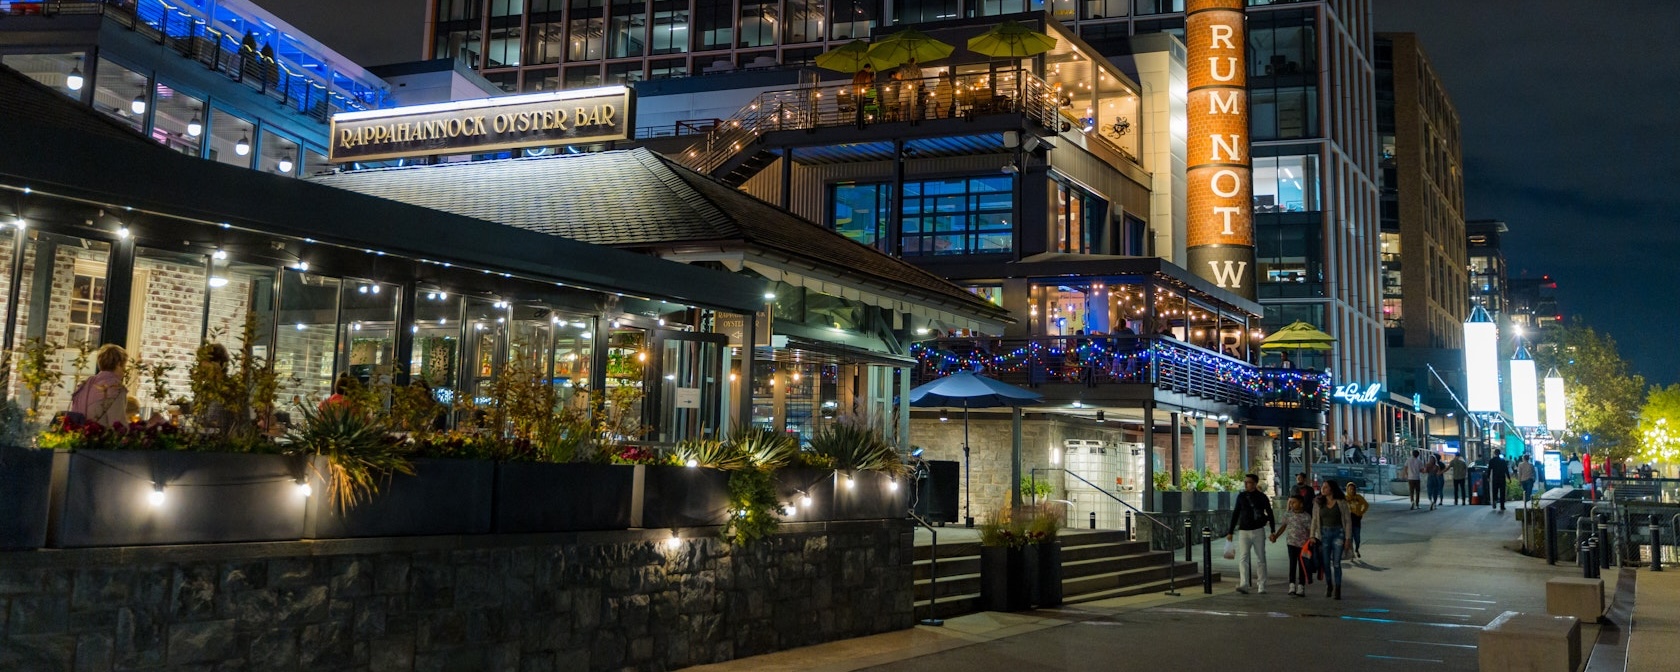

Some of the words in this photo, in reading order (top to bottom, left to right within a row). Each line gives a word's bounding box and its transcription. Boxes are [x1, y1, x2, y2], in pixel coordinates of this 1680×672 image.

[1208, 24, 1240, 115] RUM
[340, 115, 487, 149] RAPPAHANNOCK
[493, 108, 568, 134] OYSTER
[574, 104, 616, 127] BAR
[1210, 134, 1241, 235] NOT
[1344, 383, 1381, 404] Grill
